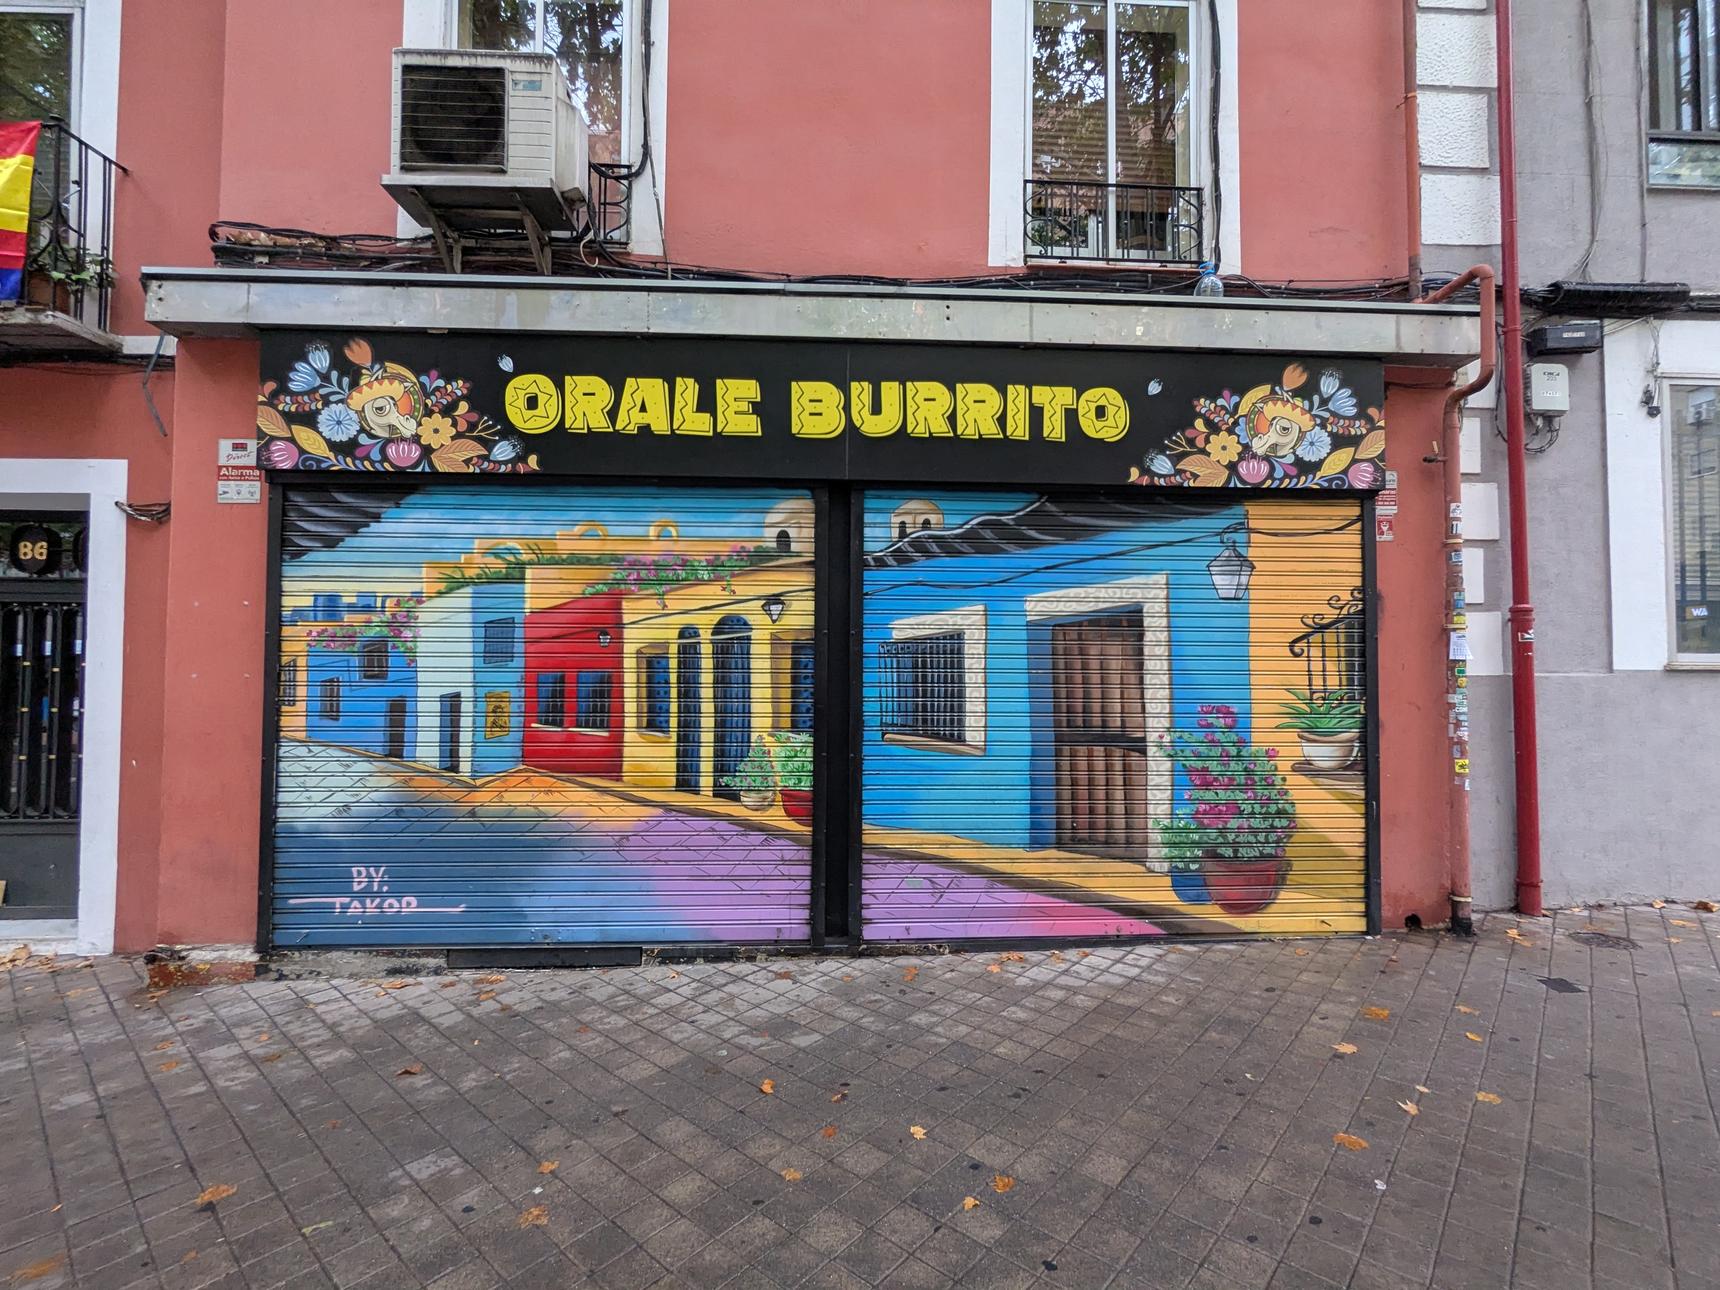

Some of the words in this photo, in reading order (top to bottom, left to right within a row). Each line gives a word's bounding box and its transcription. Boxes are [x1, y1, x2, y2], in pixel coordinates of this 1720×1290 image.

[505, 373, 762, 436] ORALE
[791, 380, 1130, 442] BURRITO
[220, 466, 260, 476] Alarma
[18, 541, 48, 560] 86
